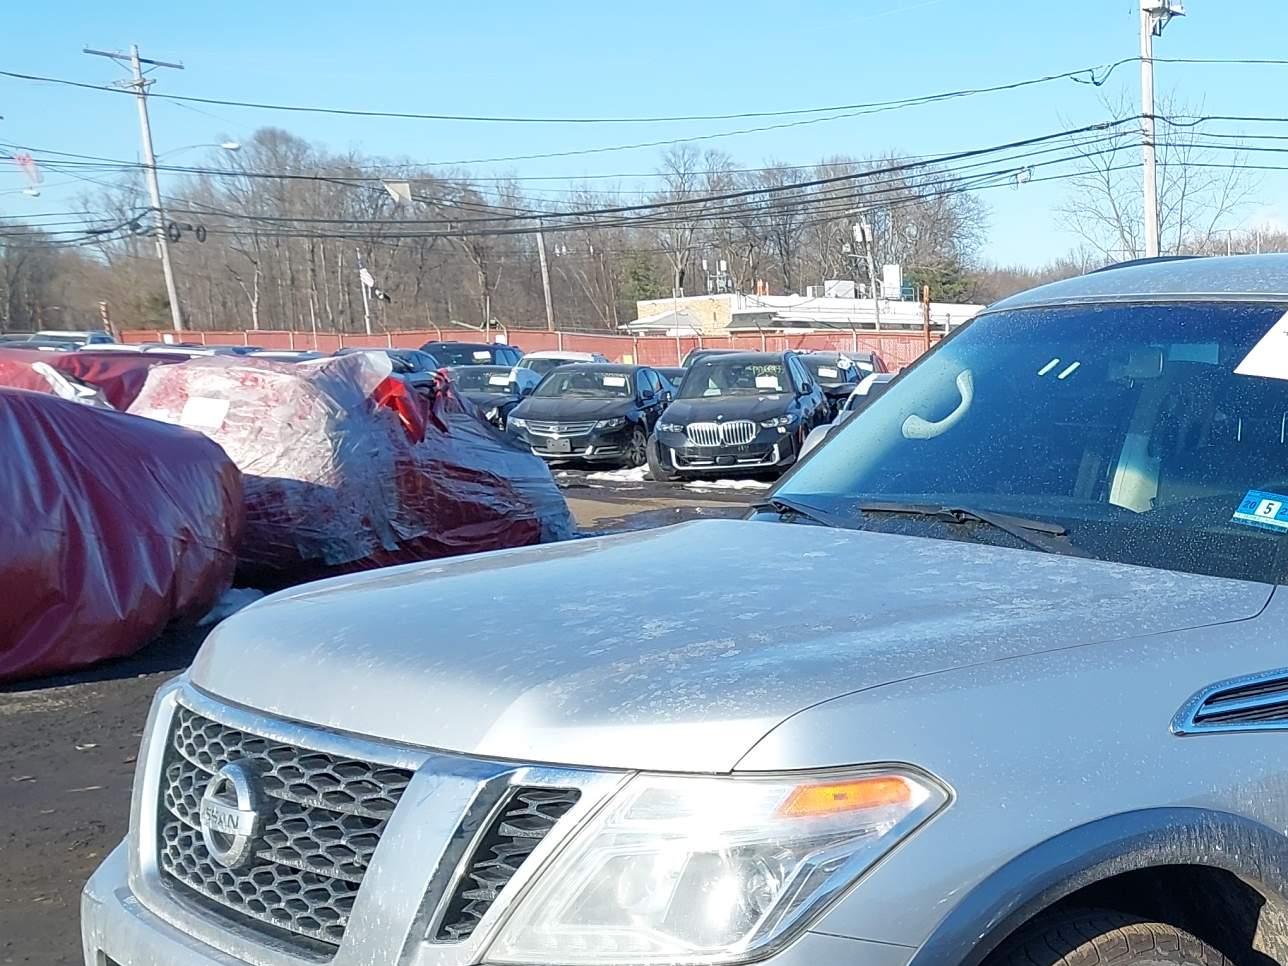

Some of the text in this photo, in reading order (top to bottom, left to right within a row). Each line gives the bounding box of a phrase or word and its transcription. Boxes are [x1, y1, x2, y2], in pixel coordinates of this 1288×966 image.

[1244, 501, 1257, 510] 20
[1263, 502, 1275, 515] 5
[204, 805, 240, 830] SSAN
